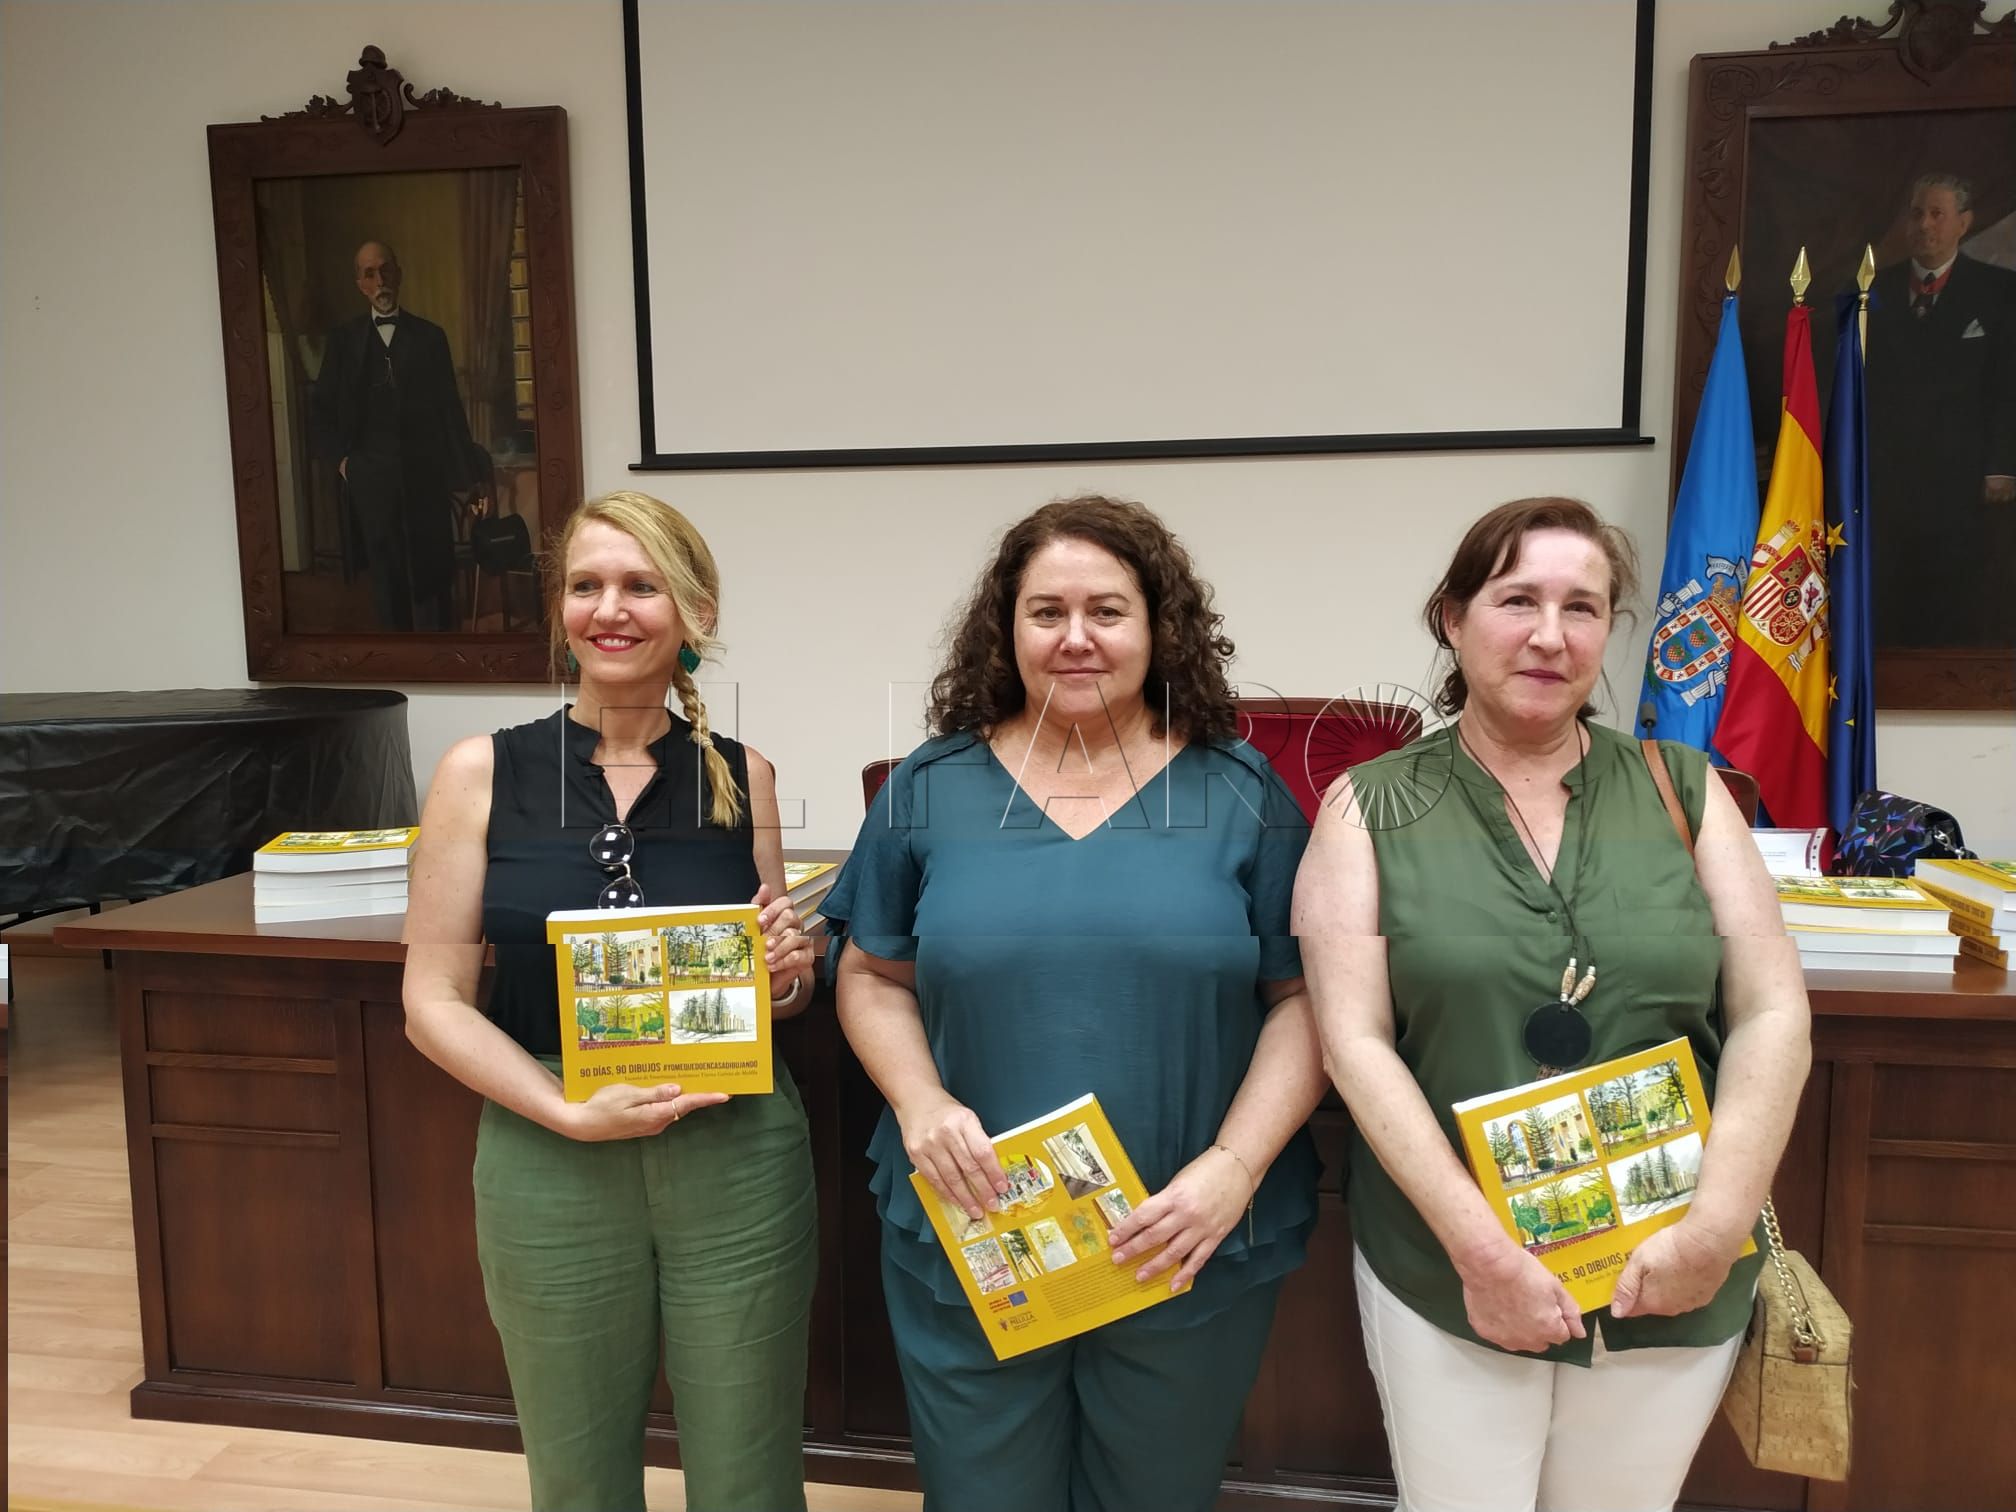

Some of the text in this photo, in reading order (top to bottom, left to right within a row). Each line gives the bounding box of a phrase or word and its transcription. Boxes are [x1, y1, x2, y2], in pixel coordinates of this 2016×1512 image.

[580, 1068, 590, 1078] 90
[593, 1065, 613, 1077] DÍAS,
[616, 1064, 626, 1074] 90
[629, 1062, 661, 1073] DIBUJOS
[1573, 1265, 1586, 1279] 90
[1586, 1252, 1623, 1274] DIBUJOS
